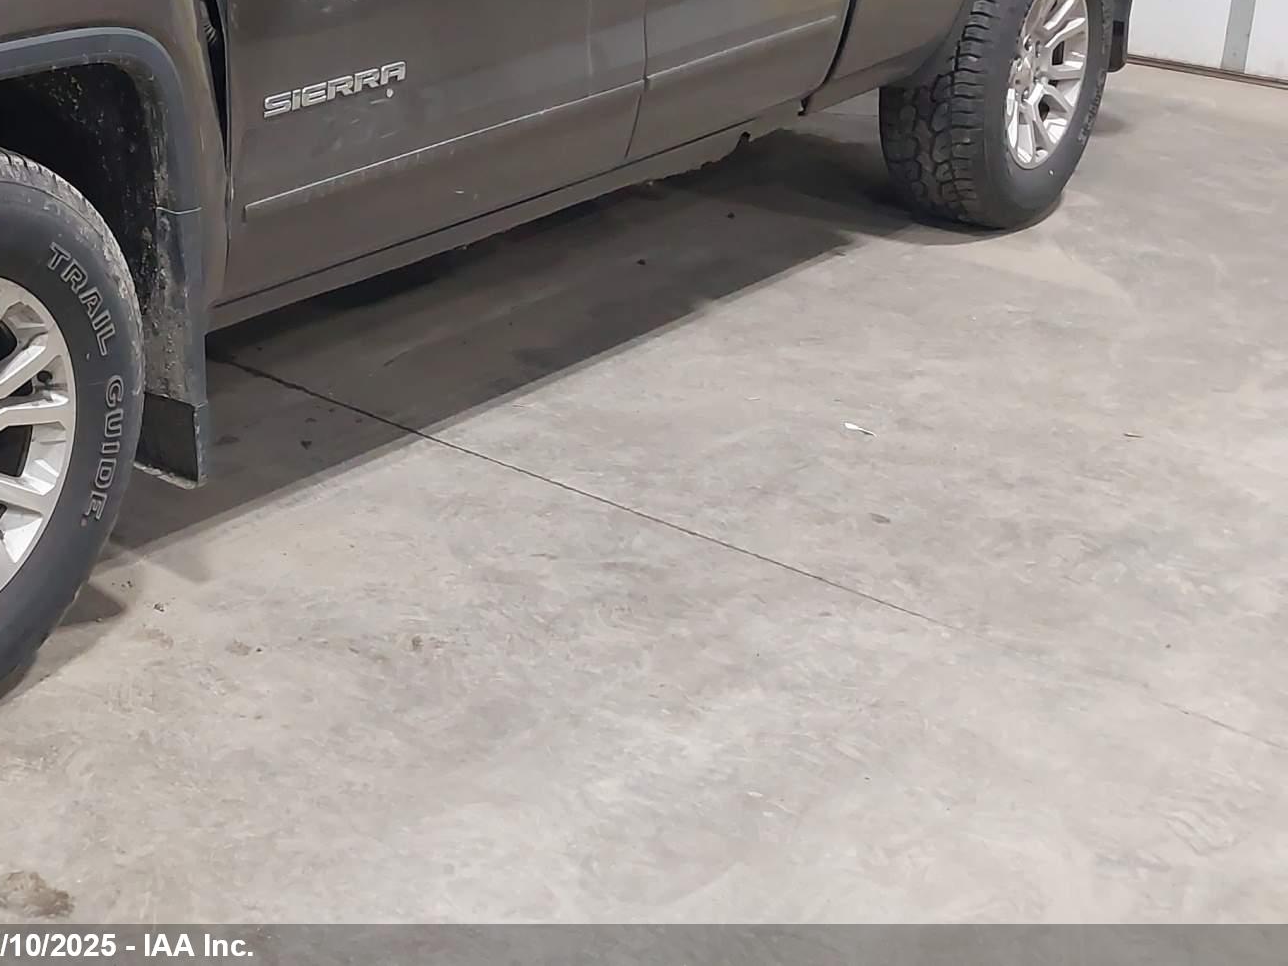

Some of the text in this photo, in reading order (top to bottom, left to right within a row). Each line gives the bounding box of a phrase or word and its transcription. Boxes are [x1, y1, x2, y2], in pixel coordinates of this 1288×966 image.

[264, 61, 406, 118] SIERRA
[47, 241, 125, 520] TRAIL GUIDE
